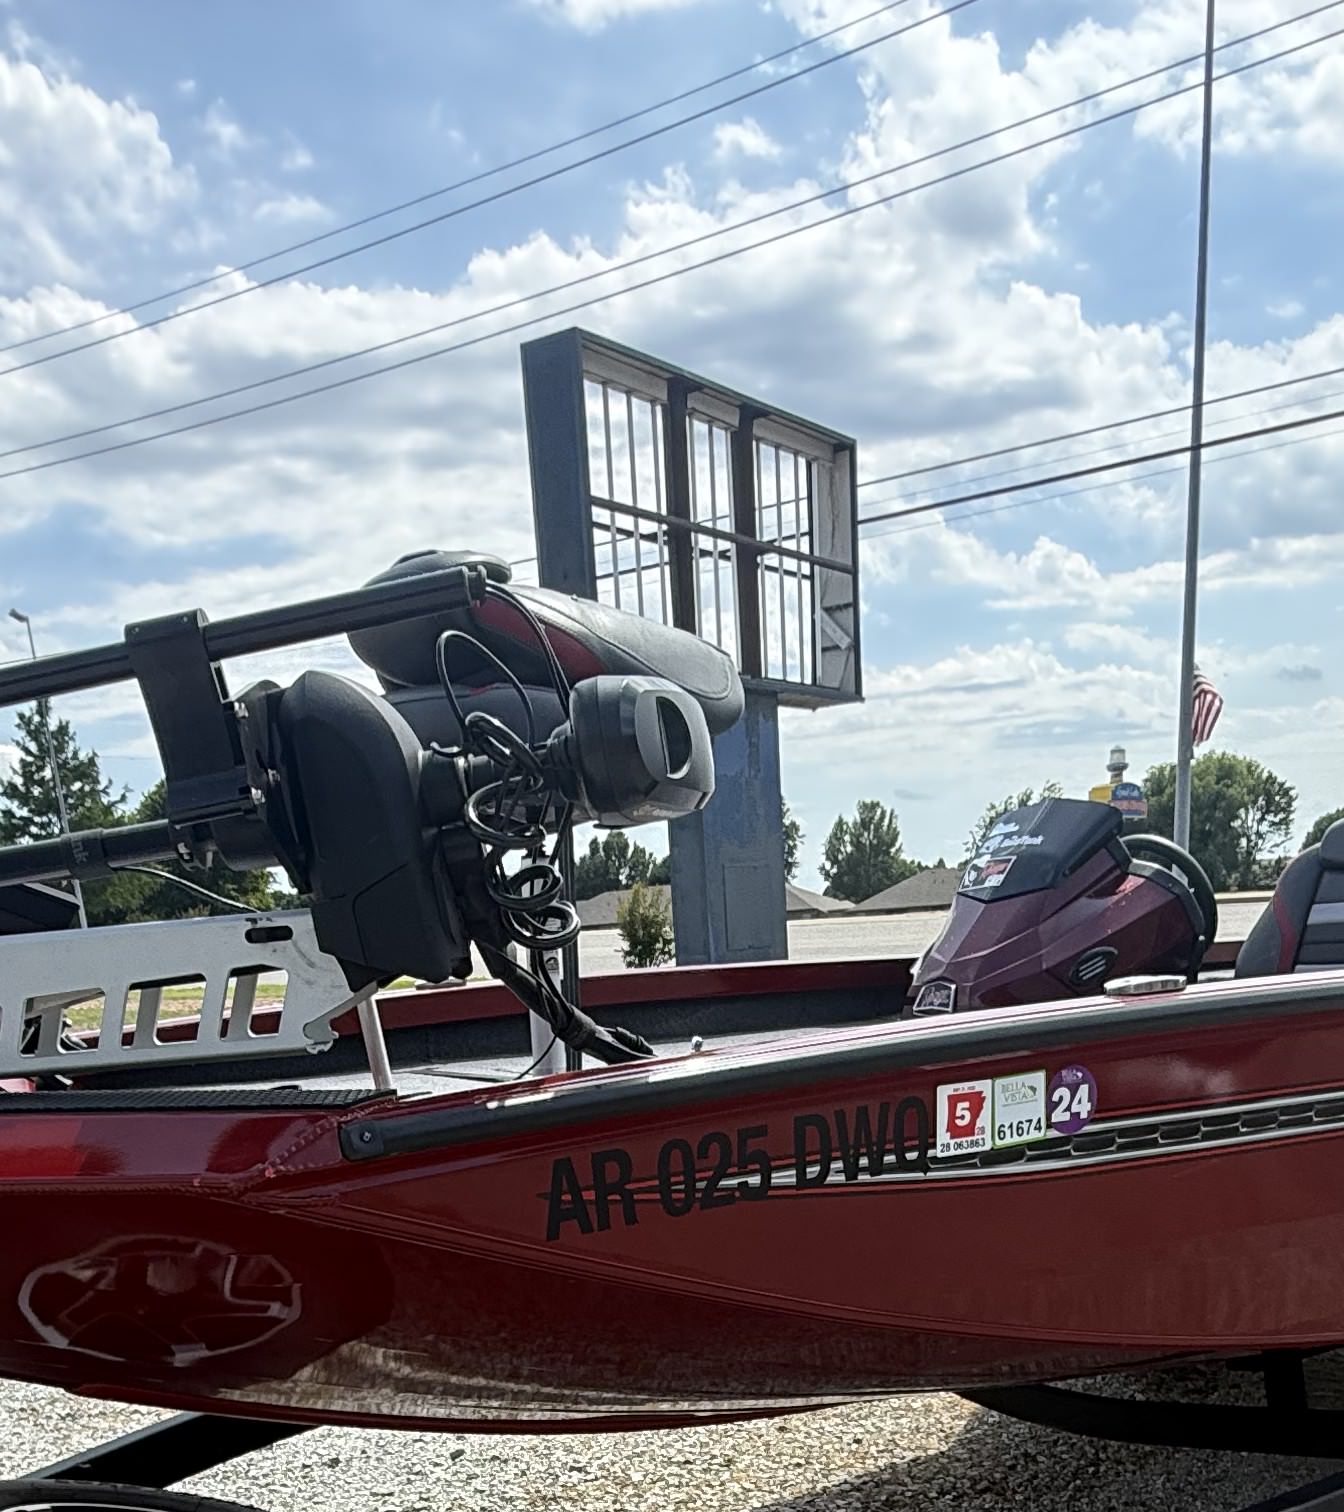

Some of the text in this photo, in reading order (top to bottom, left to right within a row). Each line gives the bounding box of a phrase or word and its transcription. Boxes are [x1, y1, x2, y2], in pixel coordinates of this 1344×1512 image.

[955, 1101, 971, 1127] 5
[1051, 1084, 1091, 1123] 24
[997, 1117, 1043, 1141] 61674
[546, 1147, 640, 1242] AR
[657, 1124, 772, 1218] 025
